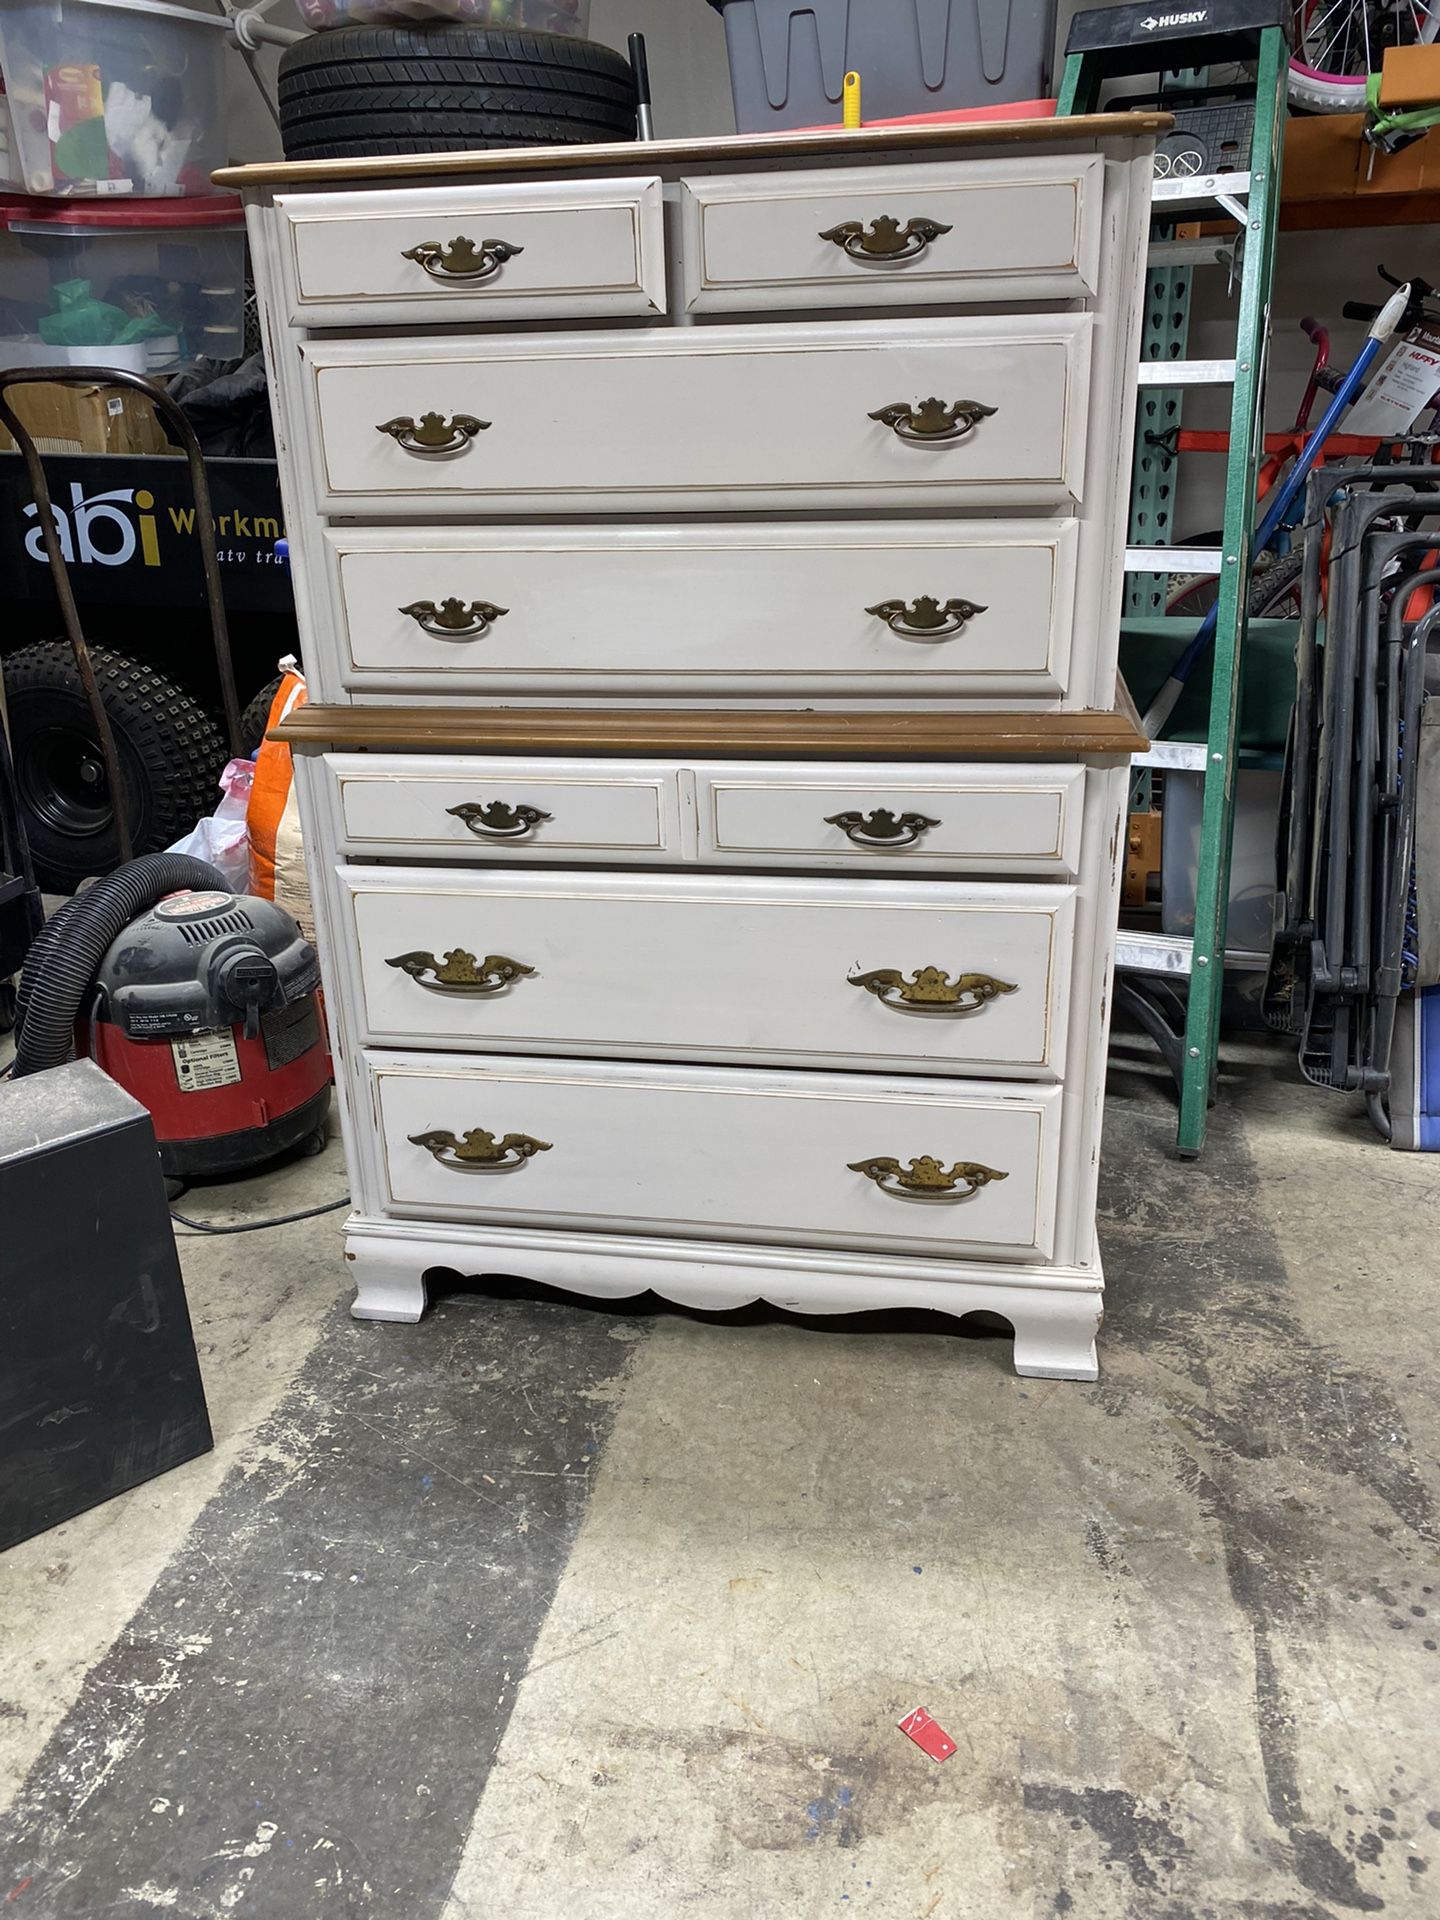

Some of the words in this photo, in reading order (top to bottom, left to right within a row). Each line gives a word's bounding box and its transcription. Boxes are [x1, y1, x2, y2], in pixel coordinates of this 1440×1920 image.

[1159, 10, 1207, 27] HUSKY
[1408, 351, 1439, 366] HUFFY
[22, 482, 161, 567] abi
[168, 507, 287, 538] Wrkm
[216, 549, 246, 562] atv
[182, 1055, 209, 1064] Optional
[209, 1051, 229, 1060] Filters
